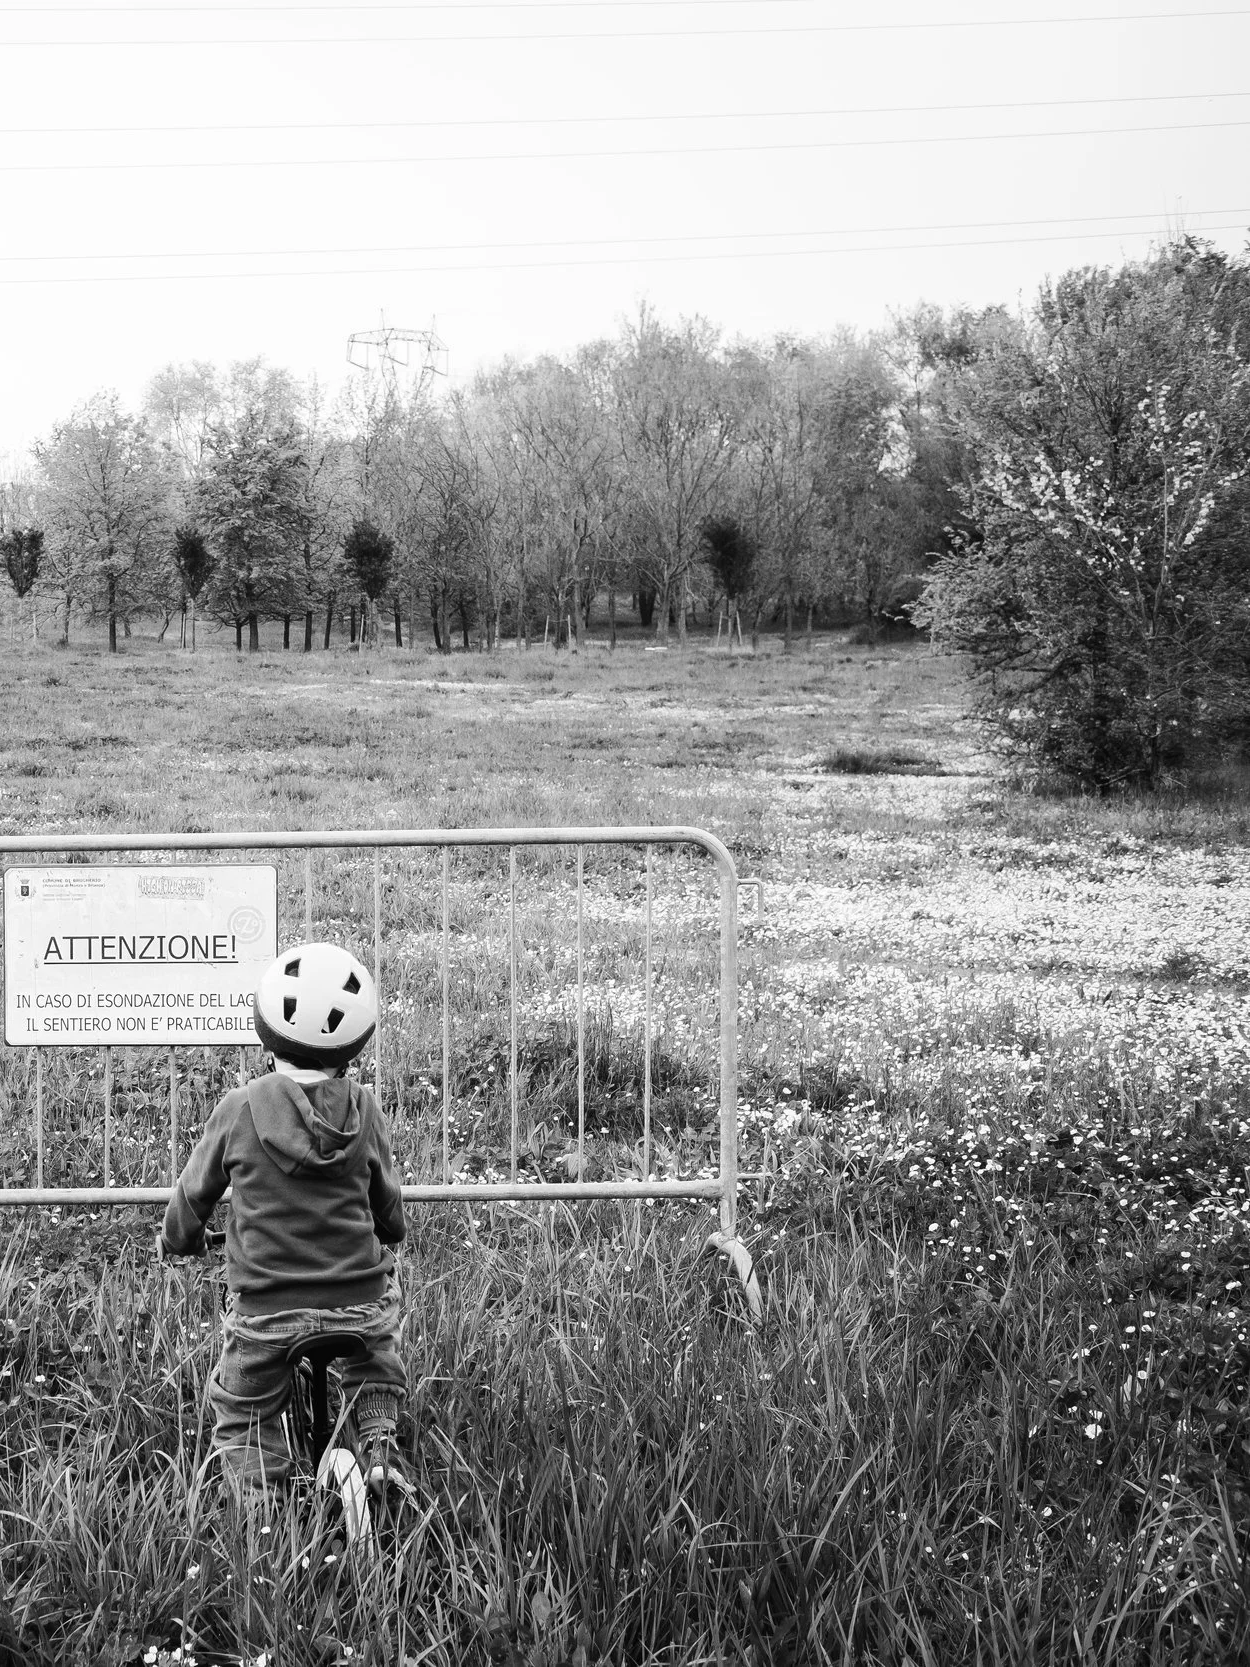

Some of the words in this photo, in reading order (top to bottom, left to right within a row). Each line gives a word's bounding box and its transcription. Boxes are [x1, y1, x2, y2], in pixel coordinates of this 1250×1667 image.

[43, 935, 236, 960] ATTENZIONE!
[16, 994, 31, 1008] IN
[36, 994, 72, 1008] CASO
[78, 994, 92, 1008] DI
[98, 994, 194, 1008] ESONDAZIONE
[199, 993, 225, 1008] DEL
[230, 993, 254, 1008] LAG
[27, 1017, 39, 1031] IL
[43, 1017, 112, 1031] SENTIERO
[117, 1017, 146, 1031] NON
[167, 1016, 254, 1031] PRATICABILE
